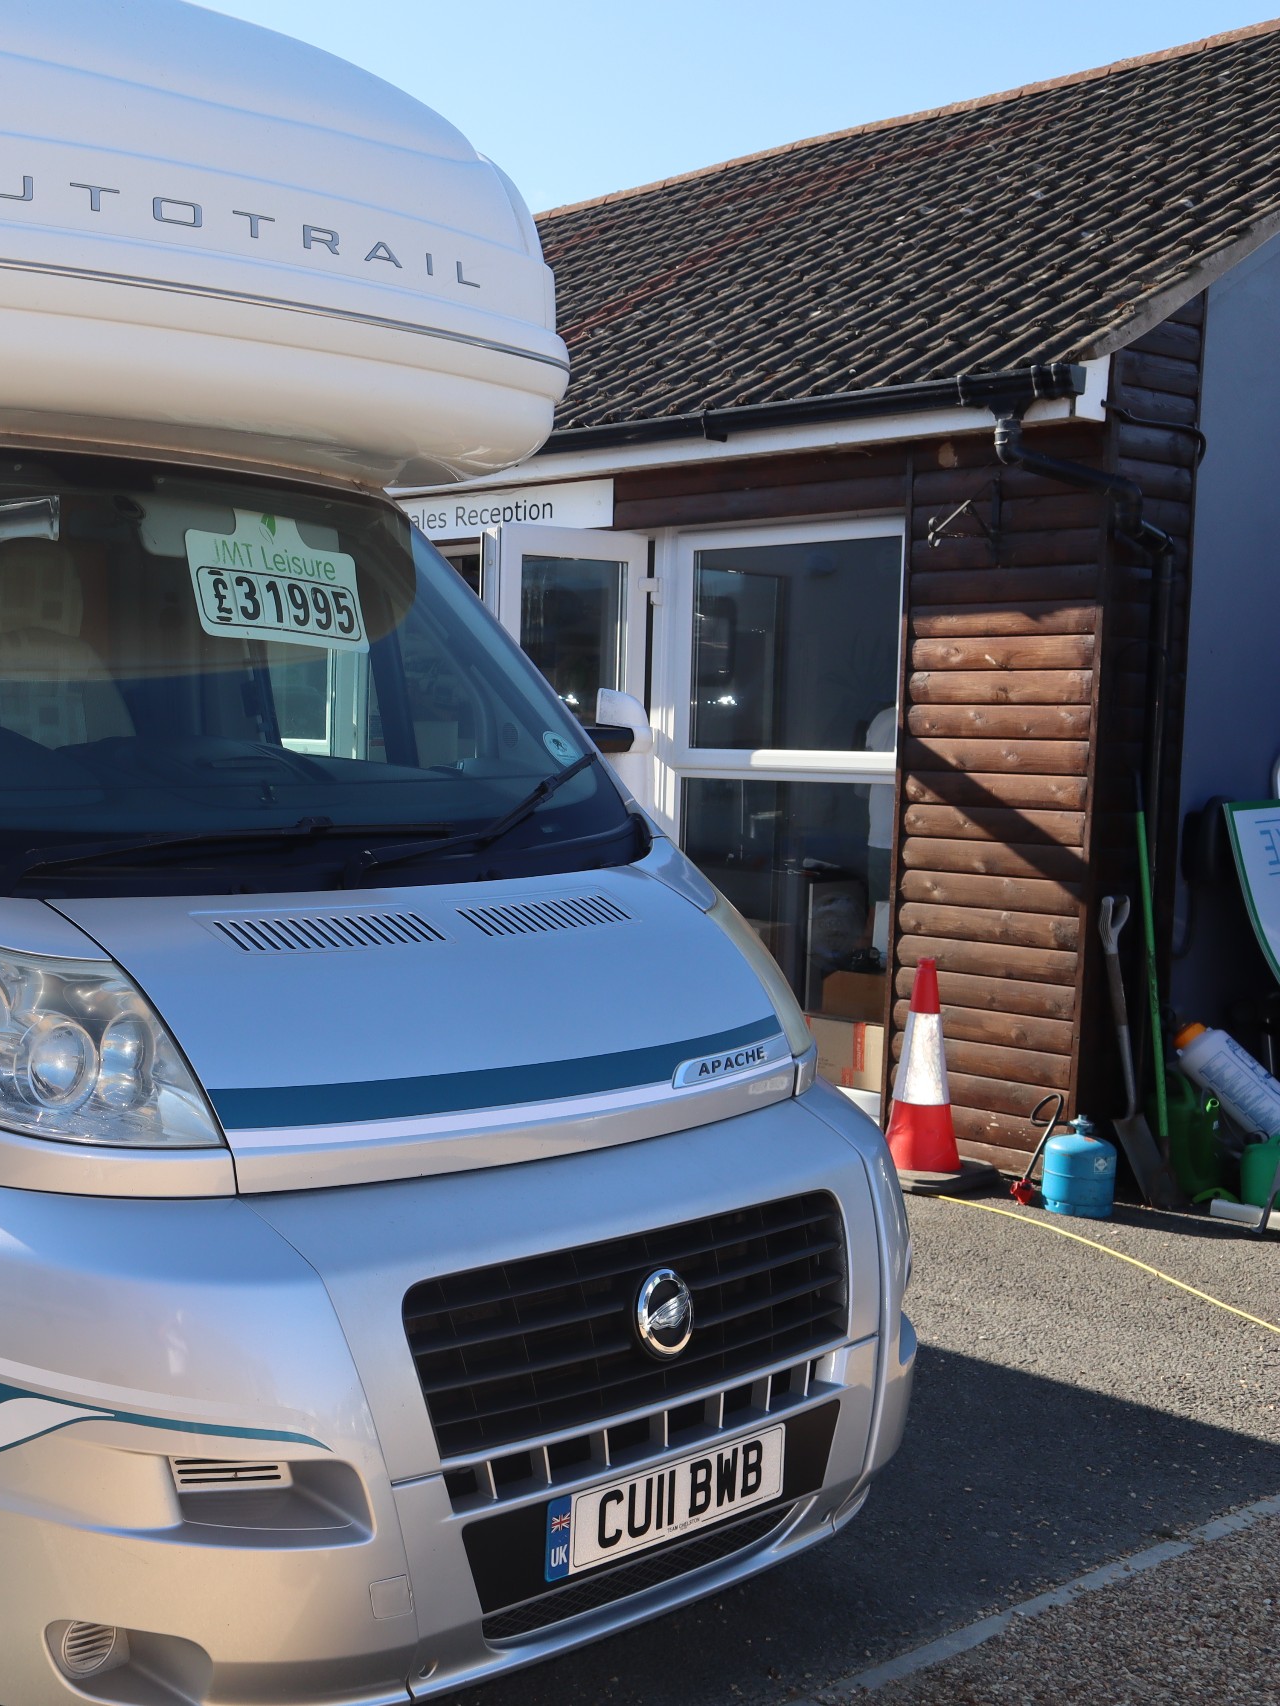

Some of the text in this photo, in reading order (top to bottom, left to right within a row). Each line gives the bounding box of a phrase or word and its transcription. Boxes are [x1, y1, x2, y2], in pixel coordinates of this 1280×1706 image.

[405, 500, 553, 530] ales Reception
[213, 539, 337, 581] JMT Leisure
[208, 570, 355, 635] £31995
[698, 1045, 765, 1077] APACHE
[597, 1439, 763, 1549] CU11 BWB
[550, 1543, 568, 1568] UK
